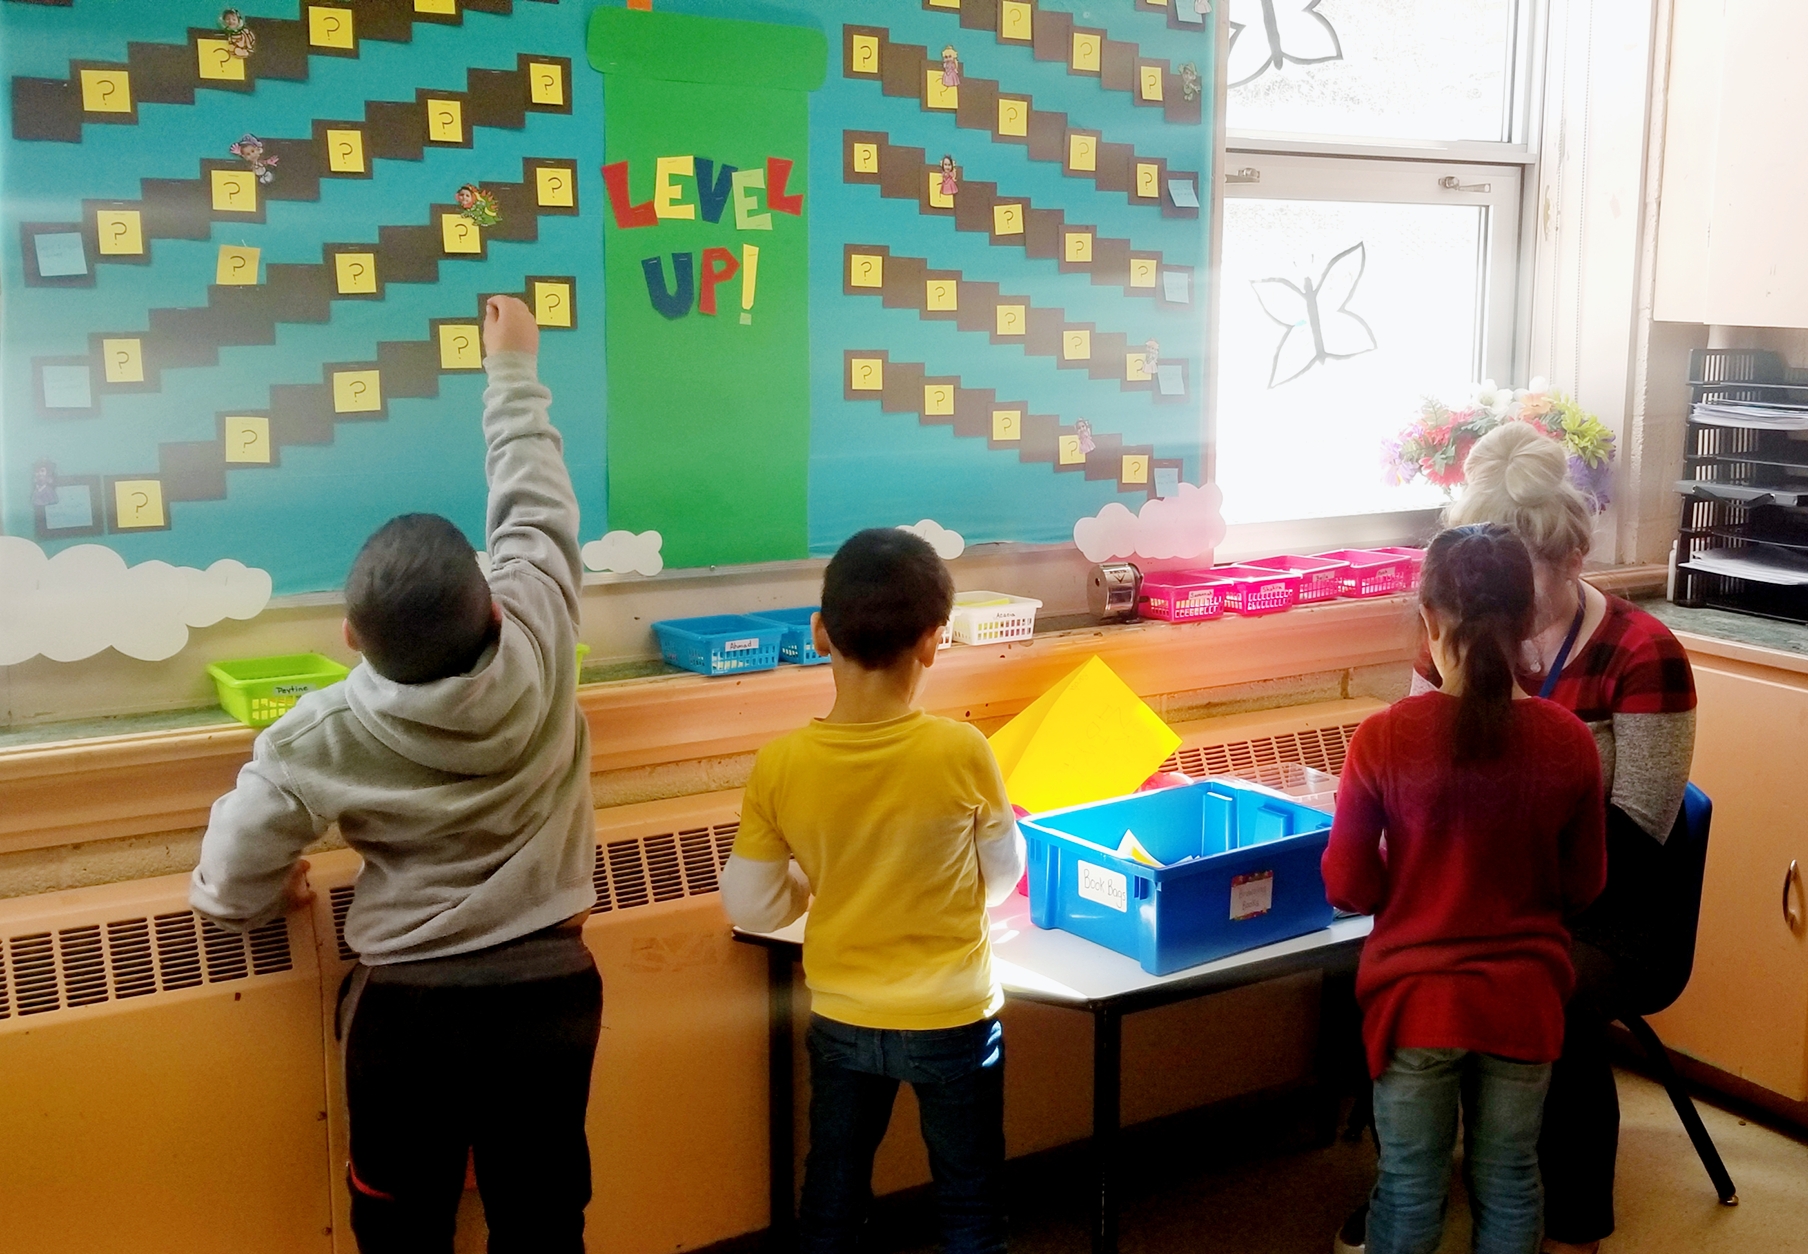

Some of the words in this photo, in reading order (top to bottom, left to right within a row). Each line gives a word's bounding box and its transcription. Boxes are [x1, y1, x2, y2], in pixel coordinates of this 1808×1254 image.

[323, 16, 341, 41] ?
[1009, 8, 1022, 29] ?
[860, 45, 873, 68] ?
[1079, 41, 1093, 65] ?
[96, 79, 115, 106] ?
[541, 74, 555, 96] ?
[1147, 74, 1157, 94] ?
[438, 111, 455, 135] ?
[1006, 106, 1018, 128] ?
[338, 142, 354, 165] ?
[862, 149, 872, 169] ?
[1078, 141, 1090, 163] ?
[547, 176, 563, 199] ?
[1143, 170, 1153, 190] ?
[223, 181, 240, 205] ?
[601, 155, 804, 230] LEVEL
[1003, 210, 1014, 229] ?
[110, 221, 128, 246] ?
[454, 223, 469, 244] ?
[1075, 239, 1085, 259] ?
[229, 255, 246, 277] ?
[348, 262, 365, 285] ?
[860, 261, 873, 281] ?
[1137, 265, 1148, 285] ?
[641, 243, 760, 325] UP!
[934, 285, 946, 305] ?
[545, 293, 561, 320] ?
[1004, 311, 1017, 330] ?
[452, 335, 469, 360] ?
[1071, 336, 1083, 355] ?
[116, 350, 130, 375] ?
[860, 364, 873, 385] ?
[349, 380, 367, 403] ?
[934, 390, 946, 411] ?
[1001, 416, 1013, 436] ?
[241, 429, 258, 454] ?
[1131, 460, 1141, 480] ?
[131, 491, 149, 519] ?
[730, 640, 752, 649] Ahmad
[1083, 868, 1105, 893] Book
[1107, 879, 1126, 909] Bags
